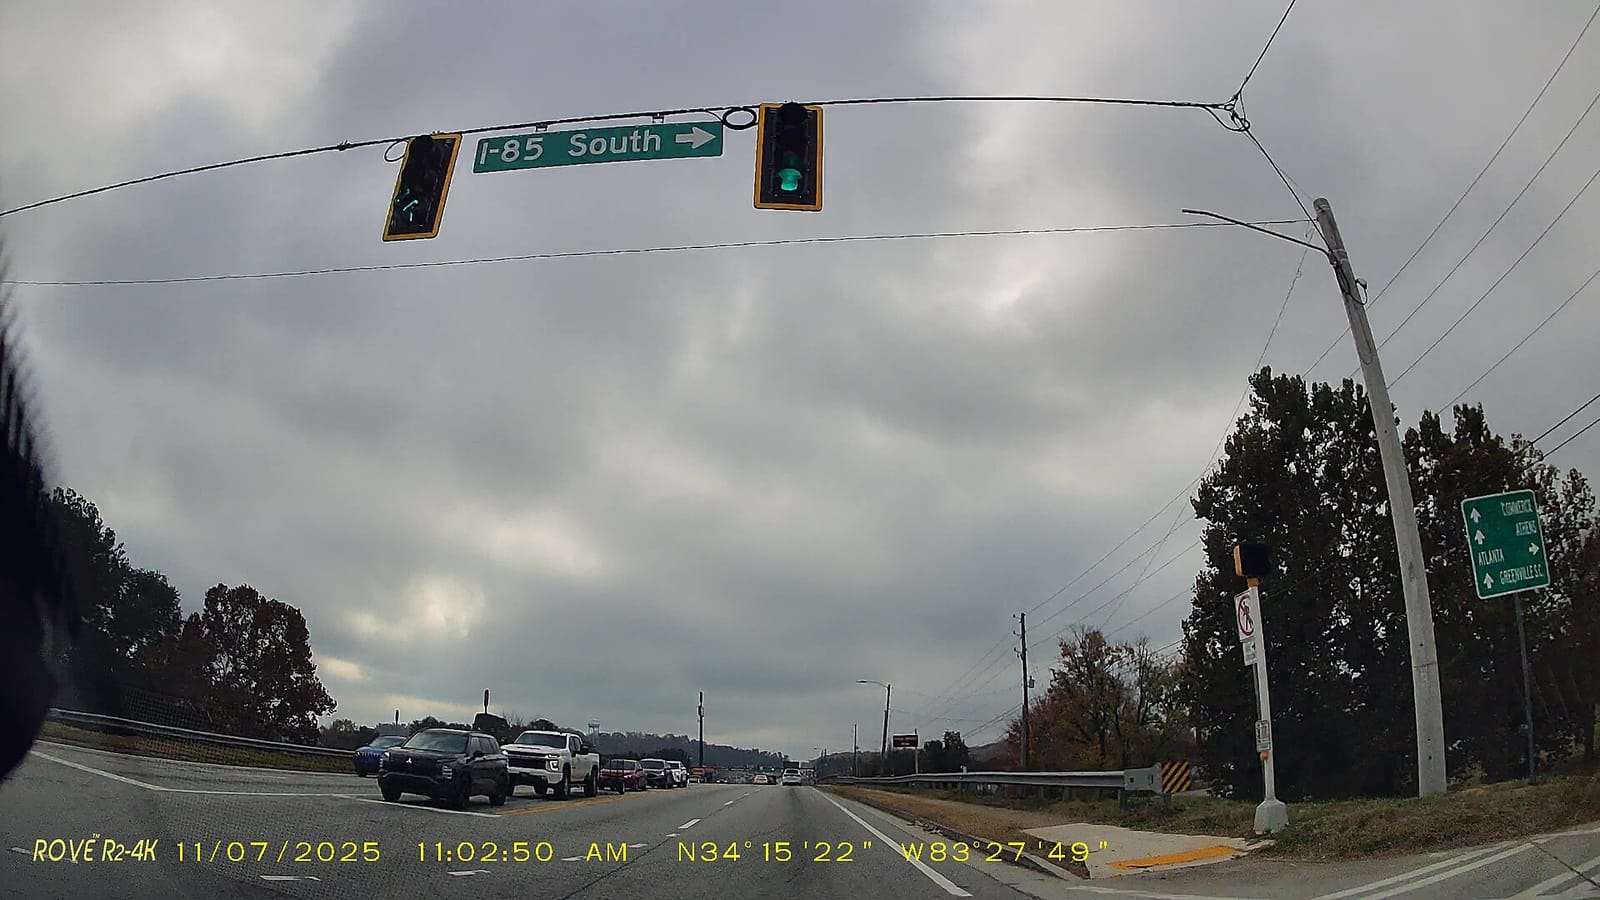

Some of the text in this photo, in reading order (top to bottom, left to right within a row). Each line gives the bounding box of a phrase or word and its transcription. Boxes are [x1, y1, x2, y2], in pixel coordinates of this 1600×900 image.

[479, 128, 662, 165] I-85 South
[1479, 549, 1504, 566] ATLANTA
[1499, 565, 1534, 585] GREENVILLE
